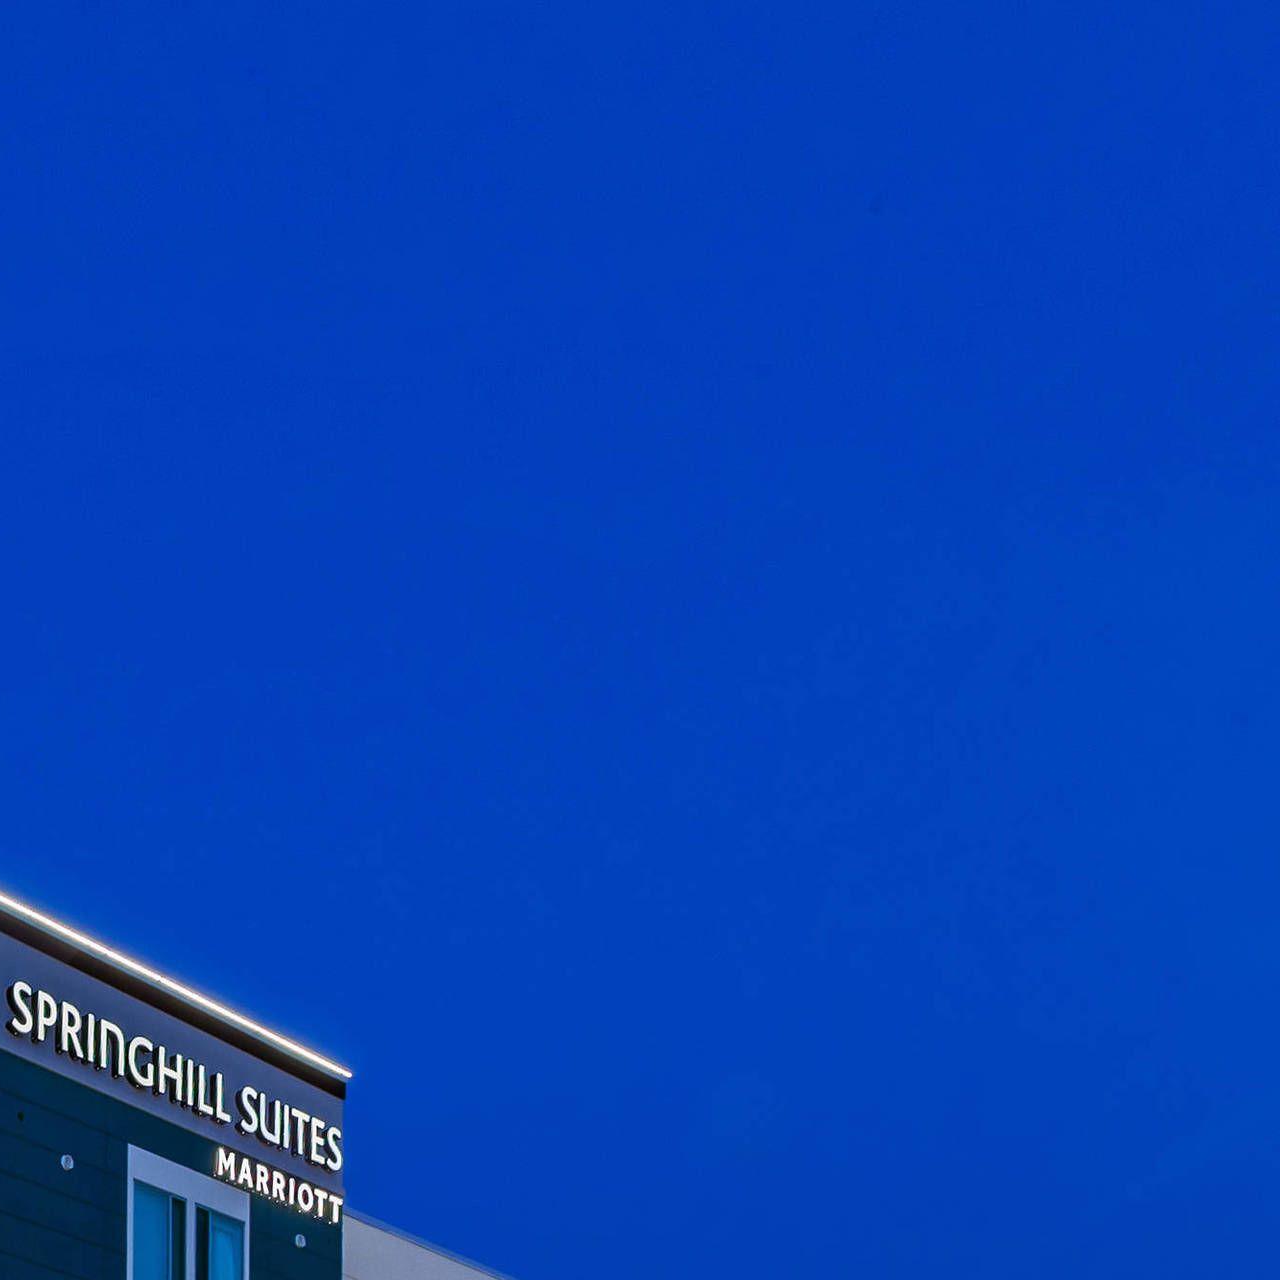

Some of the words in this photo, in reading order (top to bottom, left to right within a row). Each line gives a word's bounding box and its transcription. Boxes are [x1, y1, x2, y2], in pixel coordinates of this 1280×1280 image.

[9, 979, 231, 1124] SPRINGHILL
[239, 1085, 343, 1172] SUITES
[215, 1146, 343, 1224] MARRIOTT
